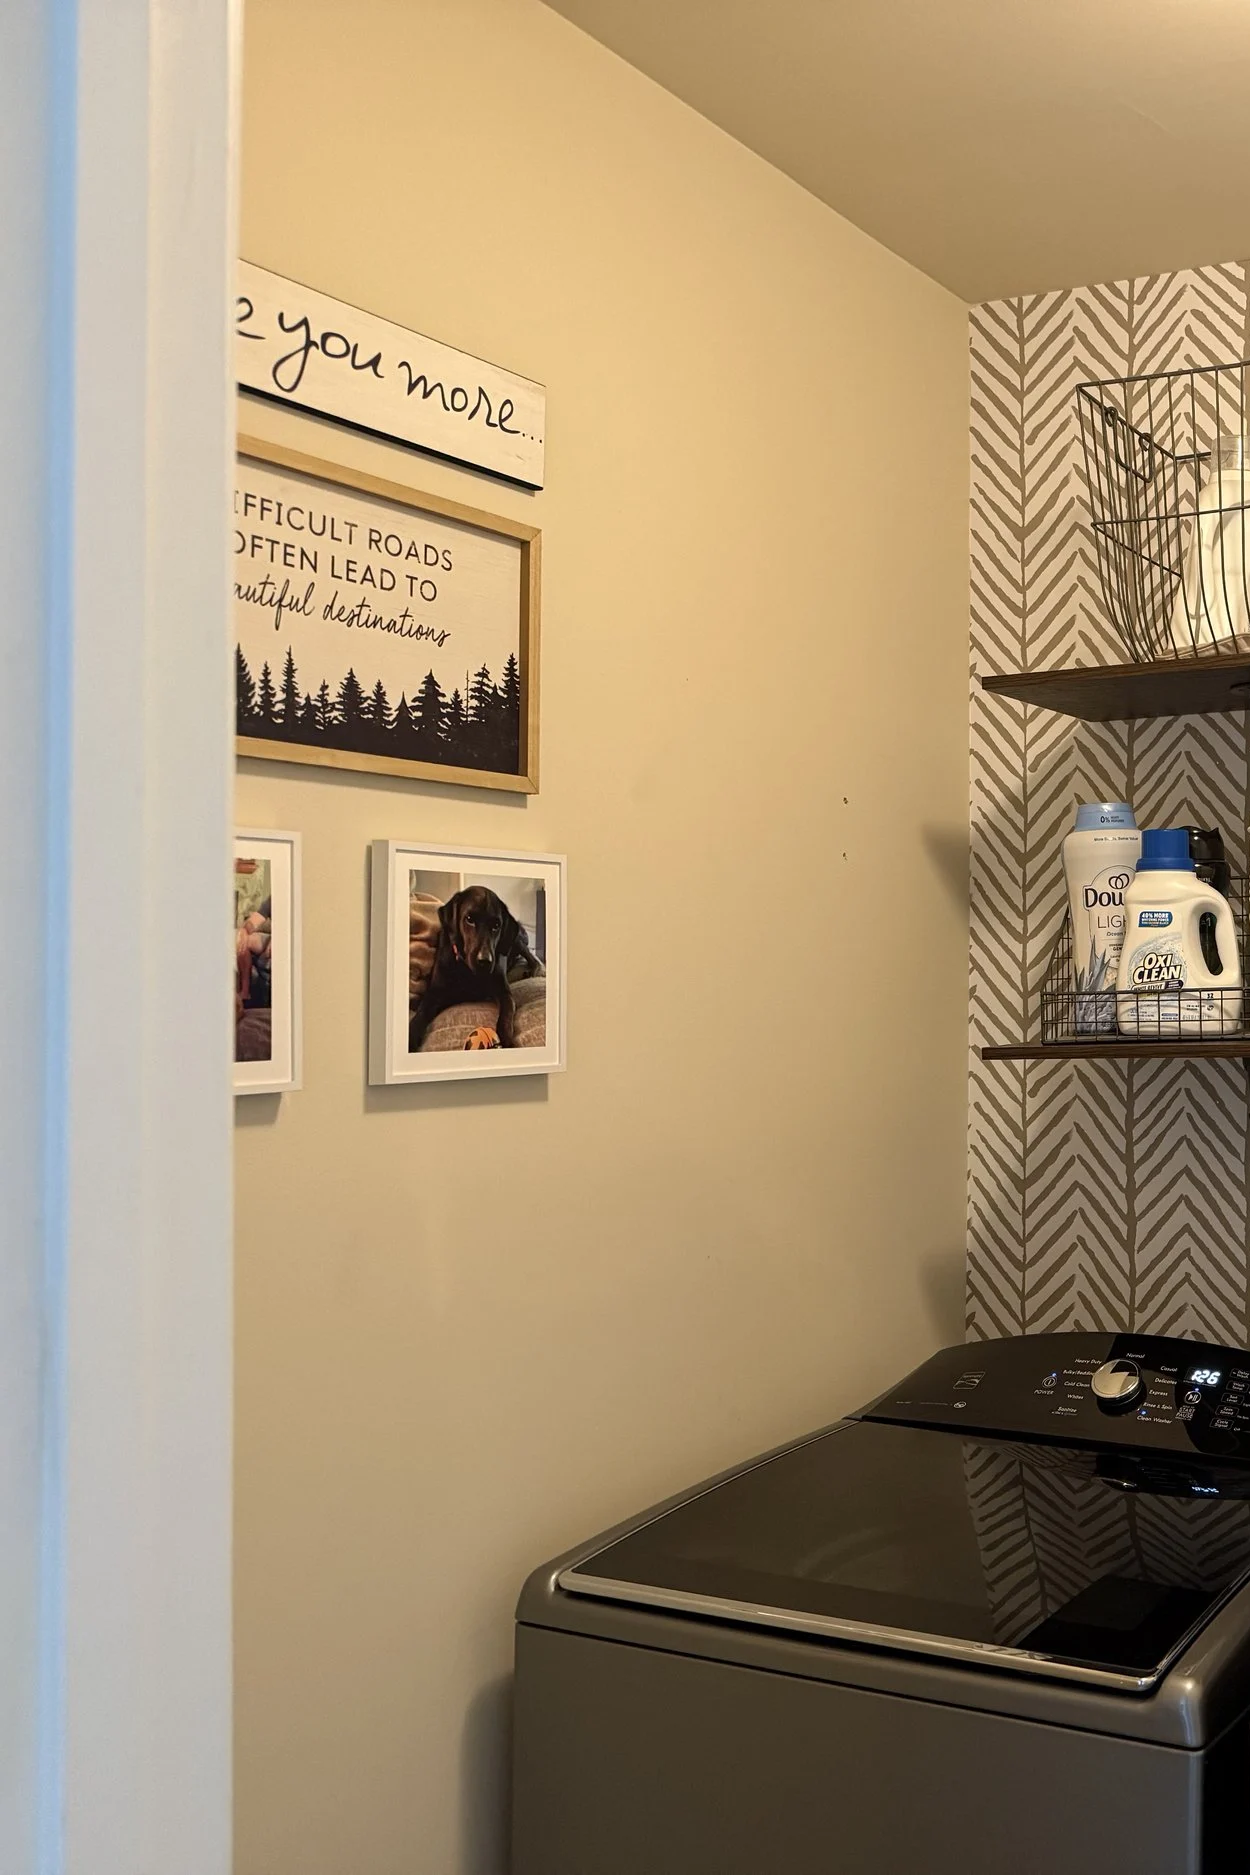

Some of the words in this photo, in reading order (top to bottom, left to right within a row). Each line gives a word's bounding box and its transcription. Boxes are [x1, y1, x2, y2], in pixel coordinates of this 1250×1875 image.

[272, 312, 384, 393] you
[368, 528, 453, 571] ROADS
[331, 555, 396, 591] LEAD
[405, 574, 437, 602] TO
[323, 590, 452, 647] destinations
[1133, 965, 1182, 984] CLEAN
[1144, 952, 1173, 969] OXI
[1154, 1377, 1177, 1385] Delicates
